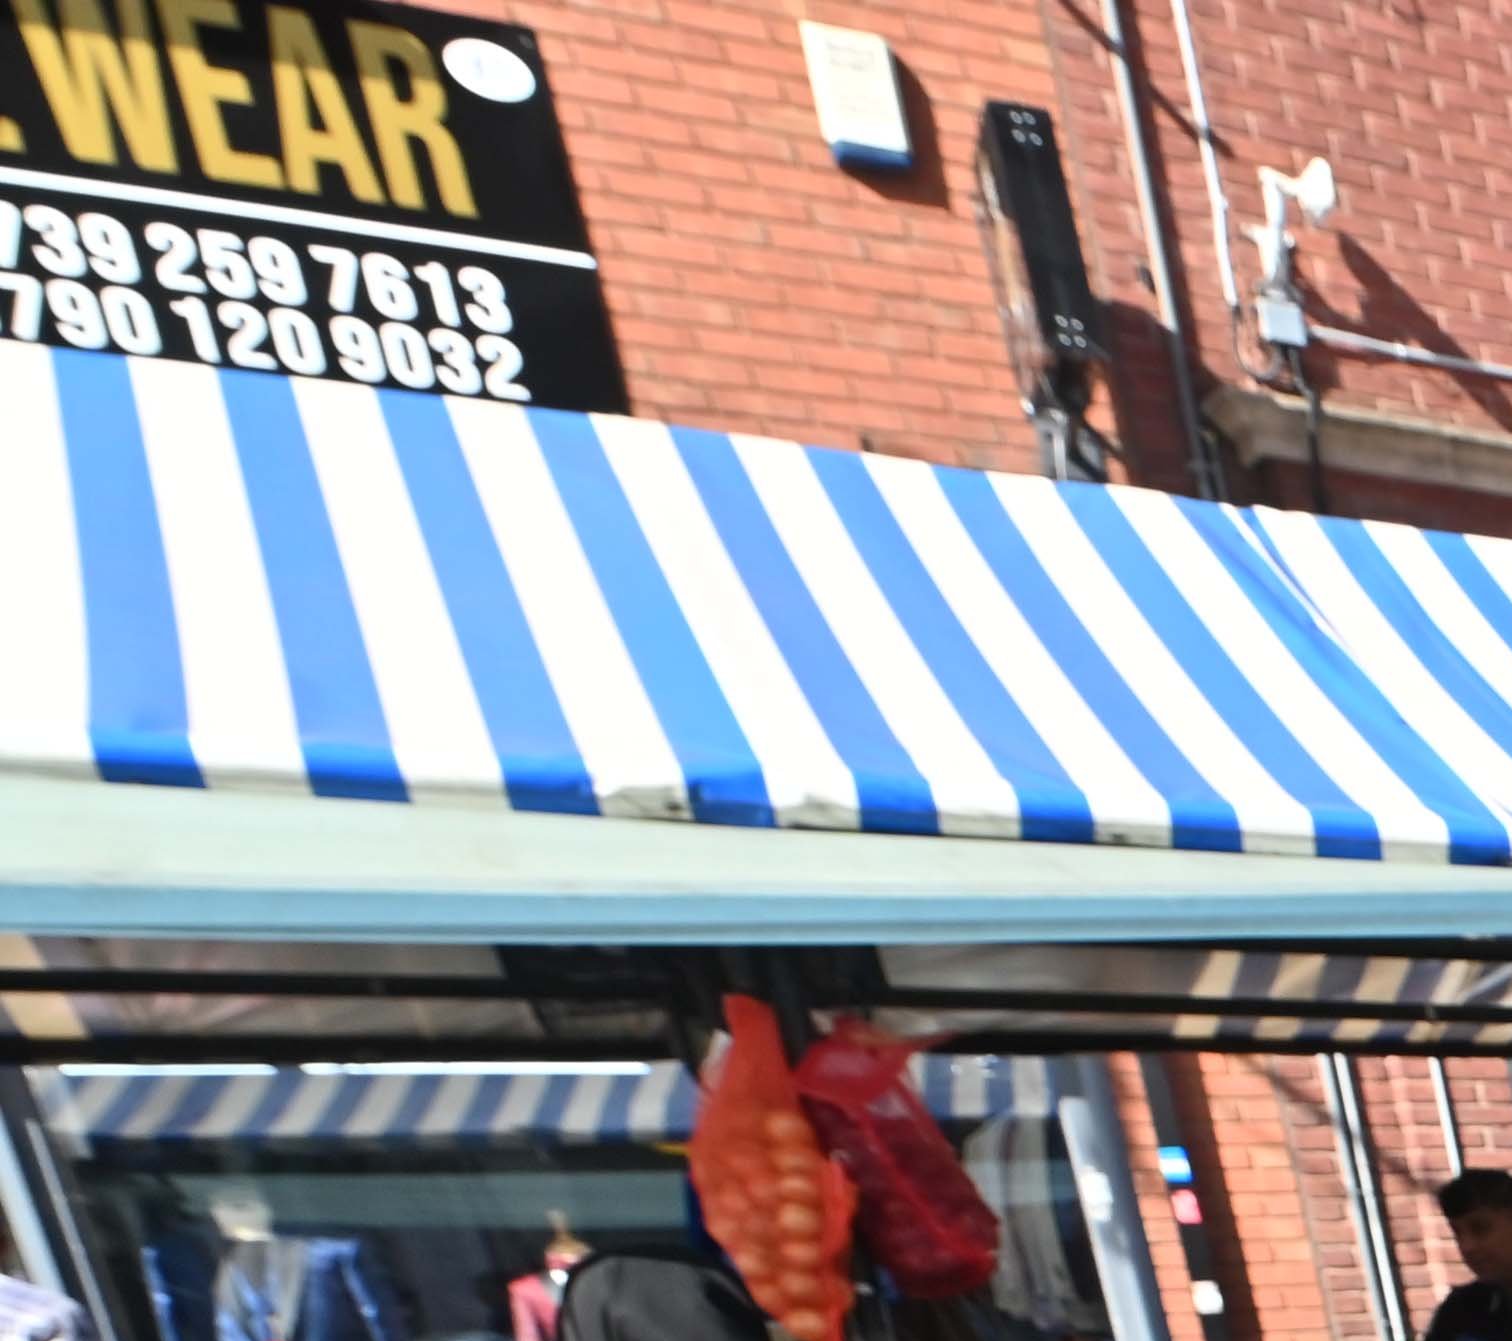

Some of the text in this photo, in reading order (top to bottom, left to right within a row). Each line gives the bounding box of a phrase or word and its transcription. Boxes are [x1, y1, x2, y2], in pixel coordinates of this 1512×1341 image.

[9, 0, 480, 218] WEAR
[144, 221, 309, 307] 259
[306, 243, 514, 335] 7613
[168, 295, 327, 376] 120
[329, 314, 533, 402] 9032
